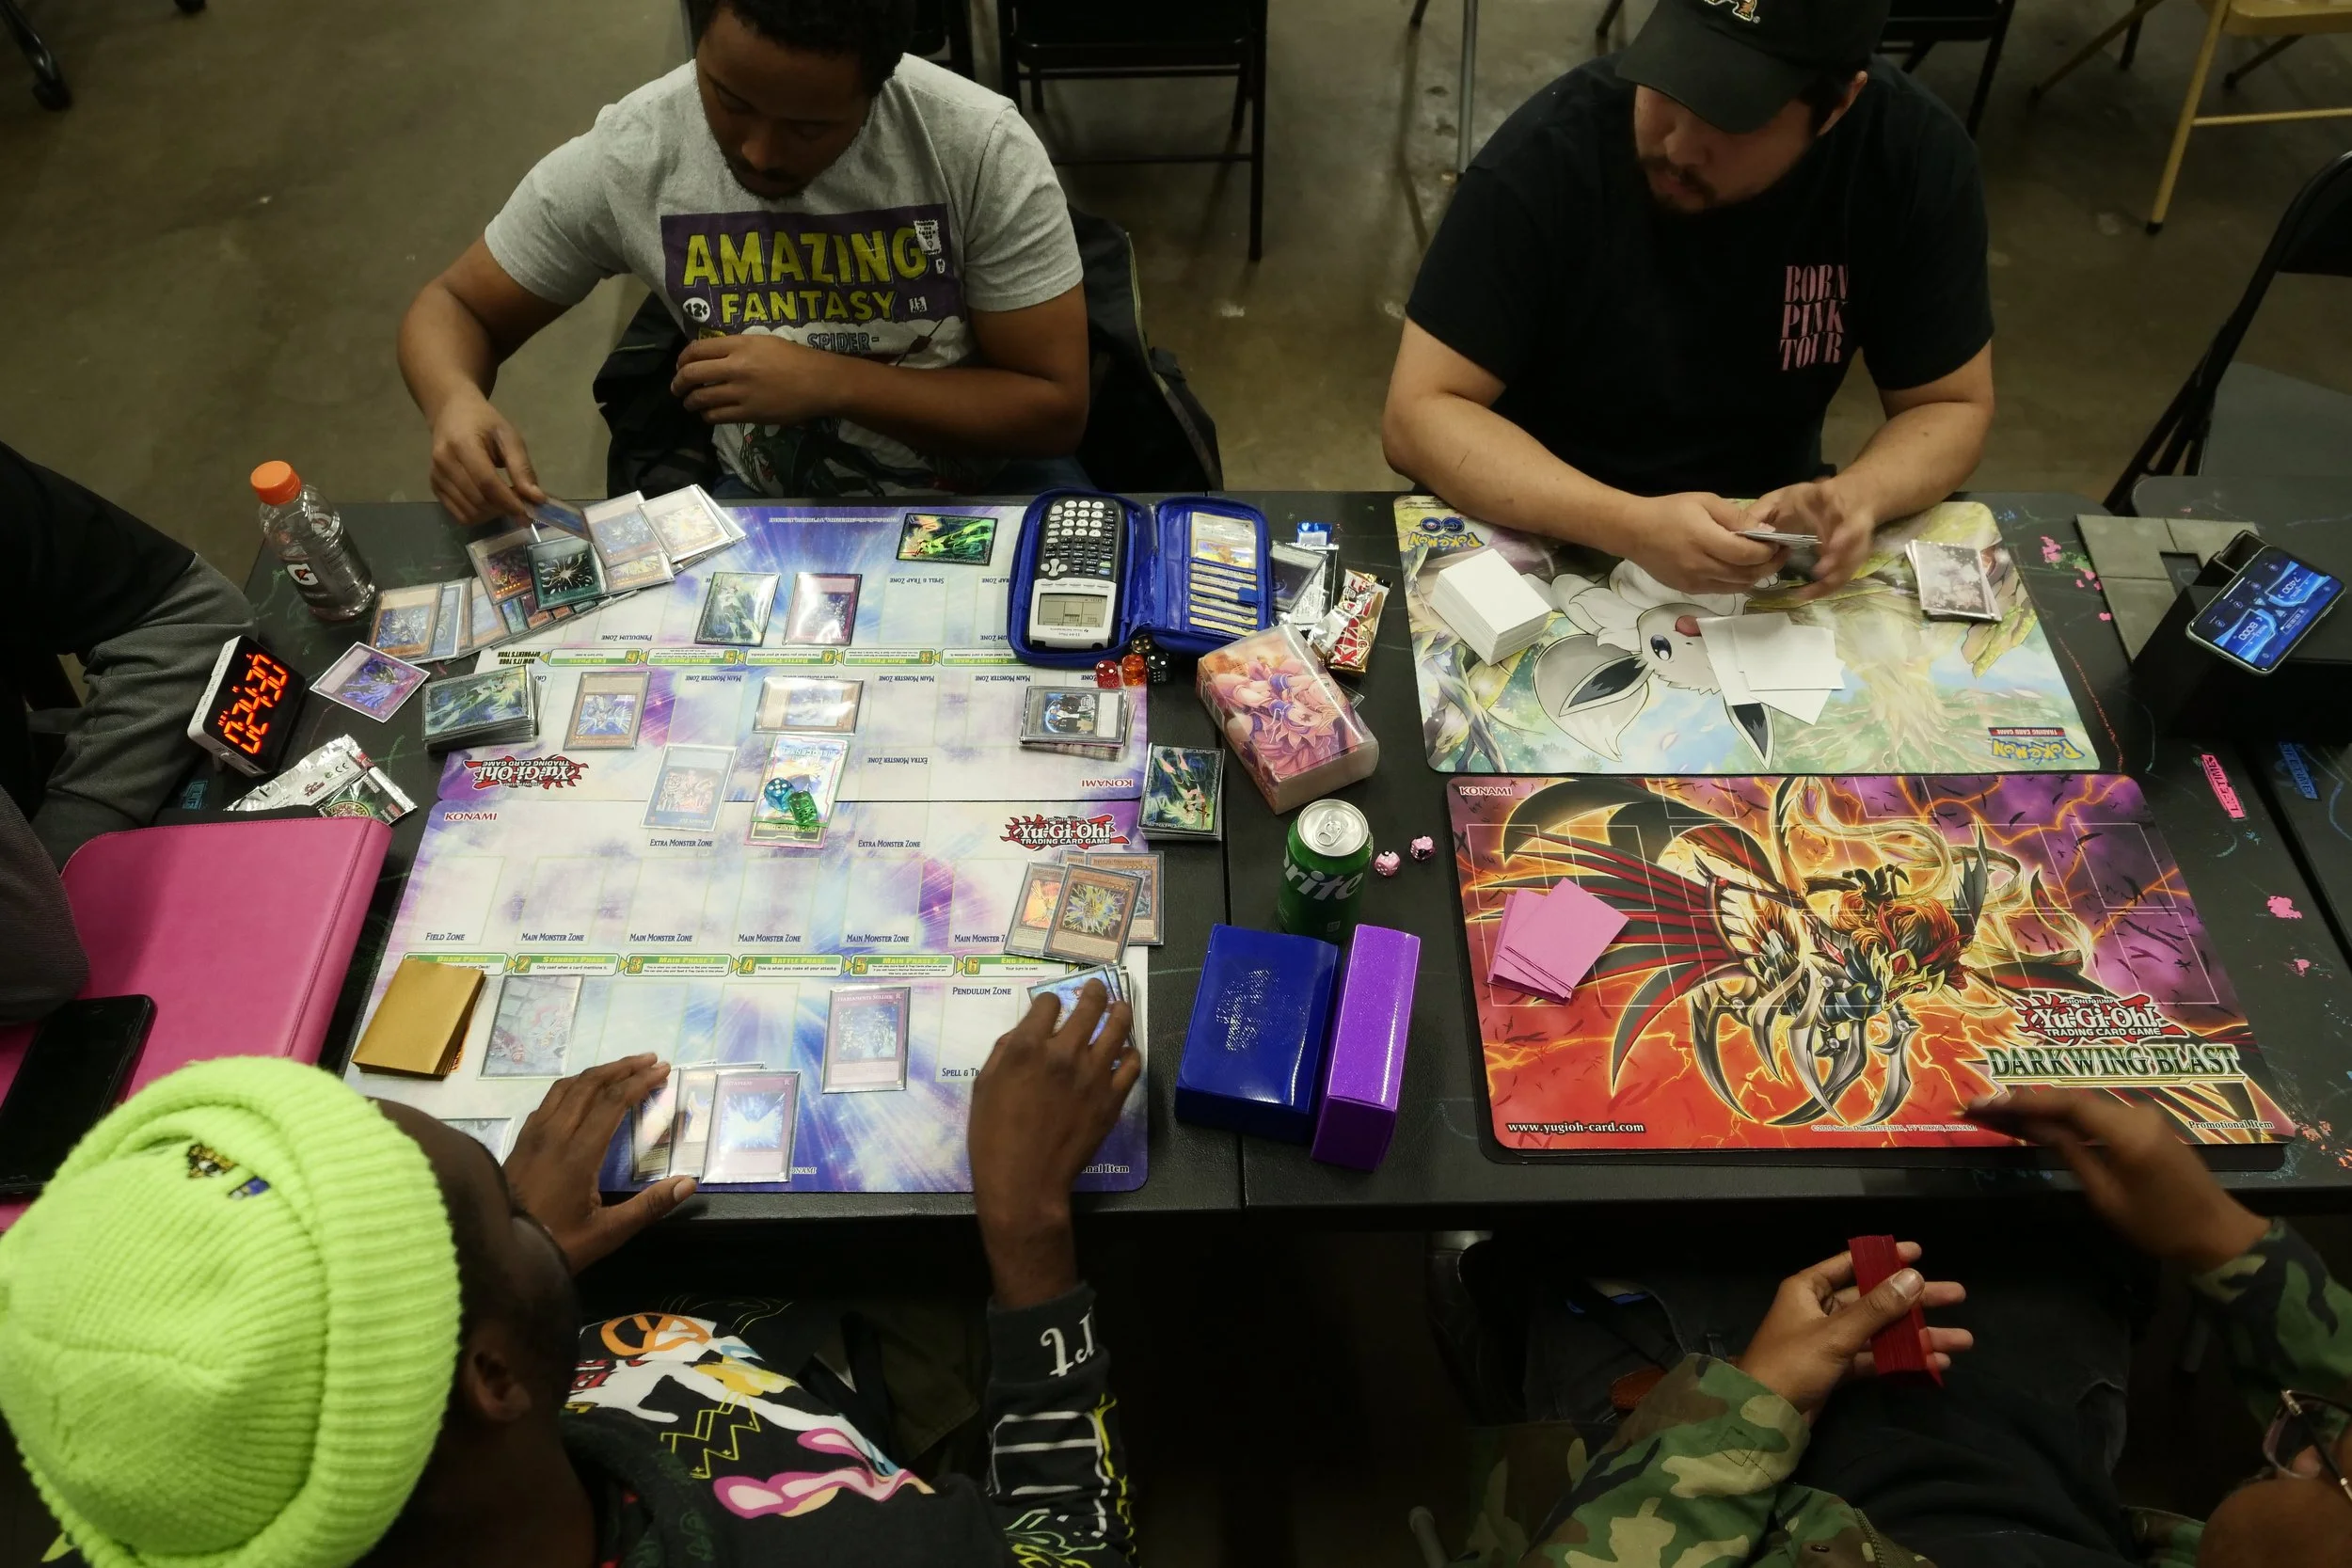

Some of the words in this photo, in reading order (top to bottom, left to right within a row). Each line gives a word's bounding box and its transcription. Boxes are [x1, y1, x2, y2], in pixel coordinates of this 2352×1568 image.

[683, 228, 929, 286] AMAZING
[1784, 264, 1849, 302] BORN
[721, 290, 896, 325] FANTASY
[1781, 299, 1849, 339] PINK
[1779, 332, 1843, 371] TOUR
[286, 562, 319, 586] G
[627, 651, 637, 663] 6
[724, 651, 735, 663] 5
[824, 651, 832, 662] 4
[473, 765, 571, 782] Yu-Gi-Oh!
[1080, 779, 1133, 788] KONAMI
[1459, 786, 1513, 797] KONAMI
[444, 812, 498, 821] KONAMI
[1019, 824, 1112, 840] Yu-Gi-Oh!
[669, 839, 696, 847] MONSTER
[697, 839, 714, 847] ZONE
[858, 839, 877, 847] EXTRA
[877, 840, 904, 848] MONSTER
[905, 840, 921, 848] ZONE
[1283, 853, 1364, 901] rite
[521, 933, 538, 942] MAIN
[538, 933, 566, 942] MONSTER
[568, 933, 585, 942] ZONE
[629, 933, 646, 942] MAIN
[647, 933, 675, 942] MONSTER
[676, 934, 692, 942] ZONE
[738, 934, 755, 942] MAIN
[756, 934, 785, 942] MONSTER
[785, 934, 802, 942] ZONE
[847, 934, 864, 942] MAIN
[864, 934, 892, 942] MONSTER
[893, 934, 909, 942] ZONE
[954, 934, 971, 942] MAIN
[971, 934, 1000, 942] MONSTER
[517, 957, 531, 972] 2
[629, 958, 643, 973] 3
[741, 958, 755, 974] 4
[854, 958, 867, 974] 5
[967, 958, 978, 974] 6
[952, 987, 991, 995] PENDULUM
[992, 987, 1012, 995] ZONE
[2039, 1006, 2156, 1029] Yu-Gi-Oh!
[2045, 1028, 2094, 1037] TRADING
[2121, 1027, 2162, 1036] GAME
[1985, 1046, 2149, 1076] DARKWING
[2150, 1045, 2245, 1075] BLAST
[942, 1069, 962, 1077] SPELL
[1507, 1121, 1645, 1133] www.yugioh-card.com
[2188, 1120, 2249, 1130] Promotional
[1104, 1164, 1130, 1174] Item
